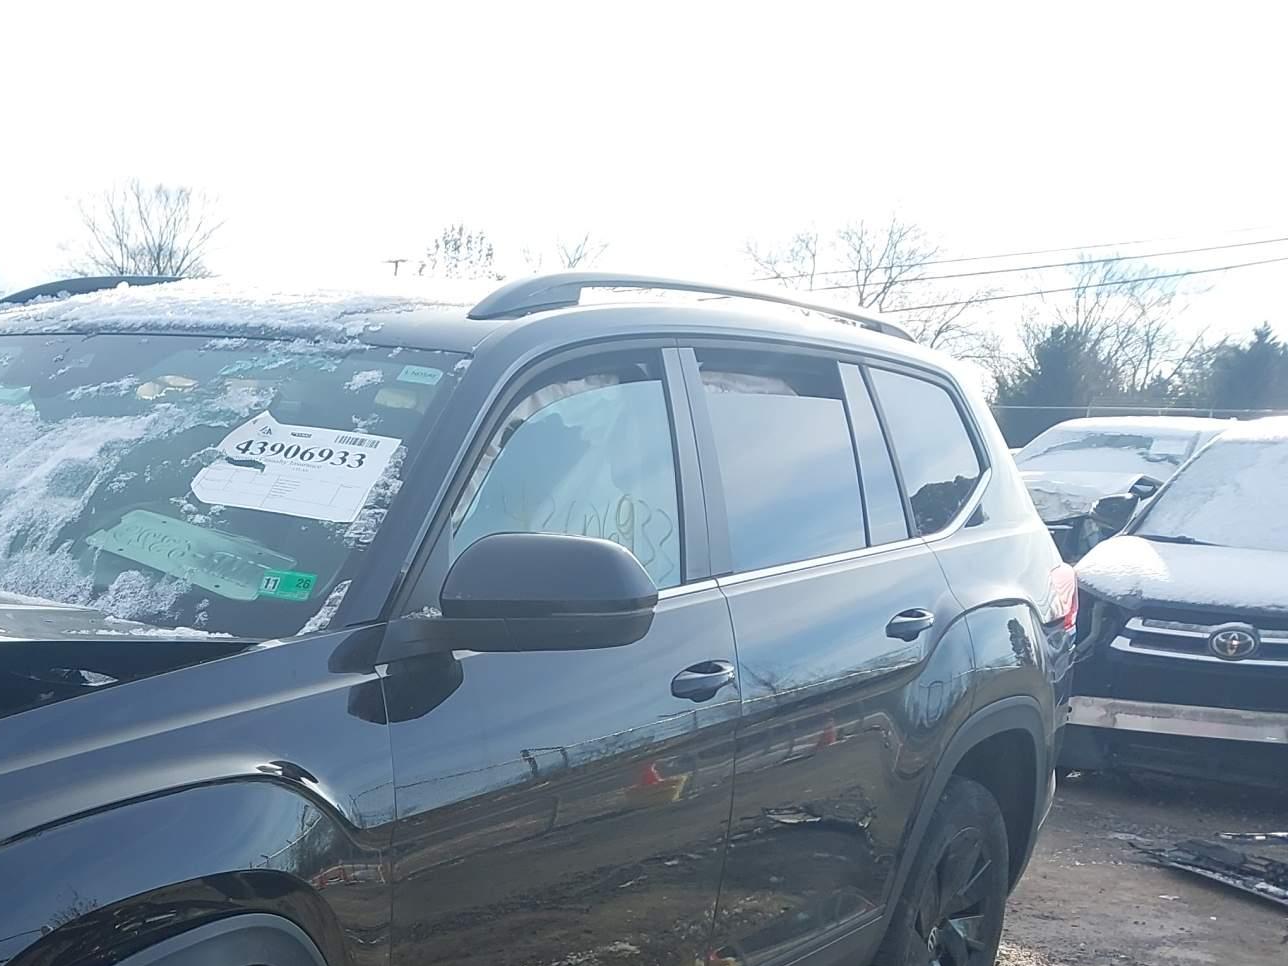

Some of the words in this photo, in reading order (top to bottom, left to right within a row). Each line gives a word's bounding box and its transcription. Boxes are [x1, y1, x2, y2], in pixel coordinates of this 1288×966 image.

[235, 439, 367, 469] 43906933
[264, 577, 279, 590] 11
[296, 578, 312, 589] 26
